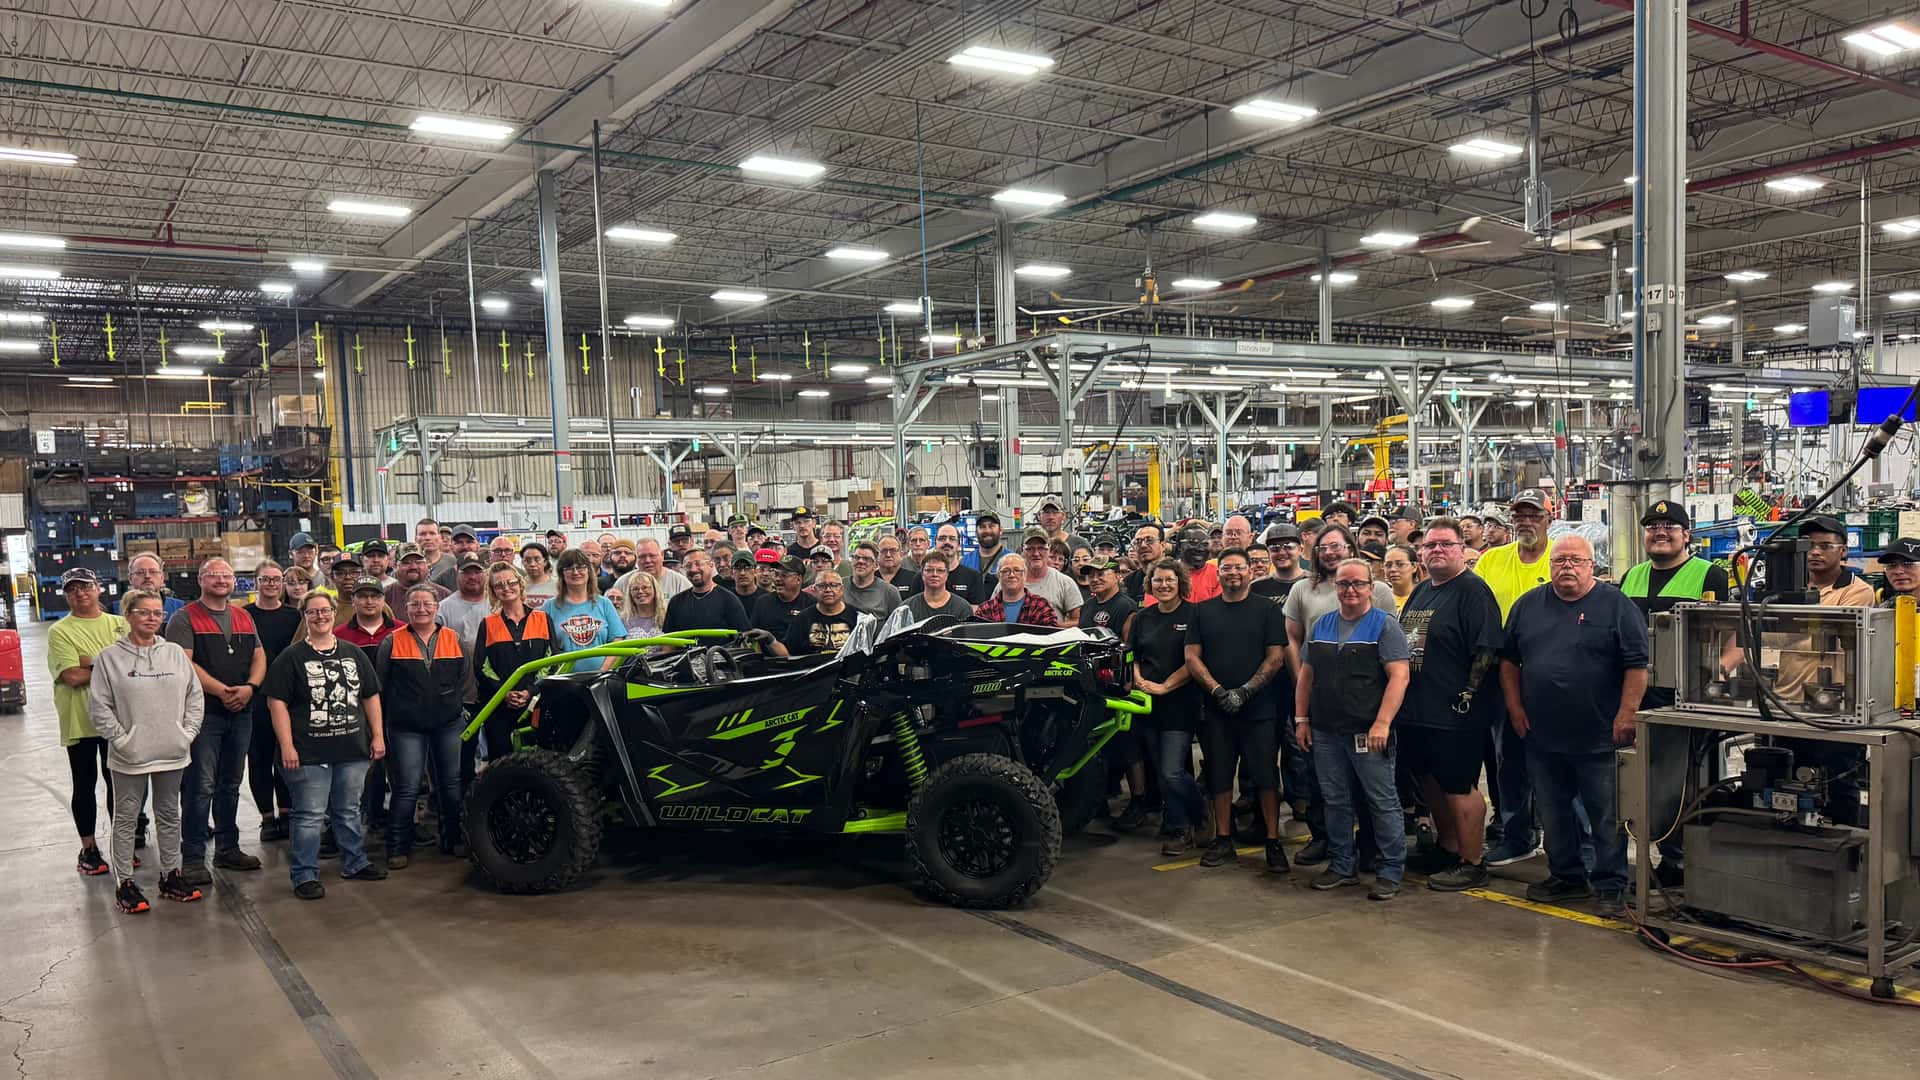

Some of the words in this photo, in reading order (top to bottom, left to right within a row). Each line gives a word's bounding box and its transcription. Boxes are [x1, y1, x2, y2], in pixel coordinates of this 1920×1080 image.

[1647, 289, 1662, 300] 17
[127, 669, 176, 680] Champion
[1044, 669, 1063, 677] ARCTIC
[1063, 669, 1074, 677] CAT
[765, 715, 787, 729] ARCTIC
[787, 711, 800, 721] CAT
[659, 805, 813, 824] WILDCAT
